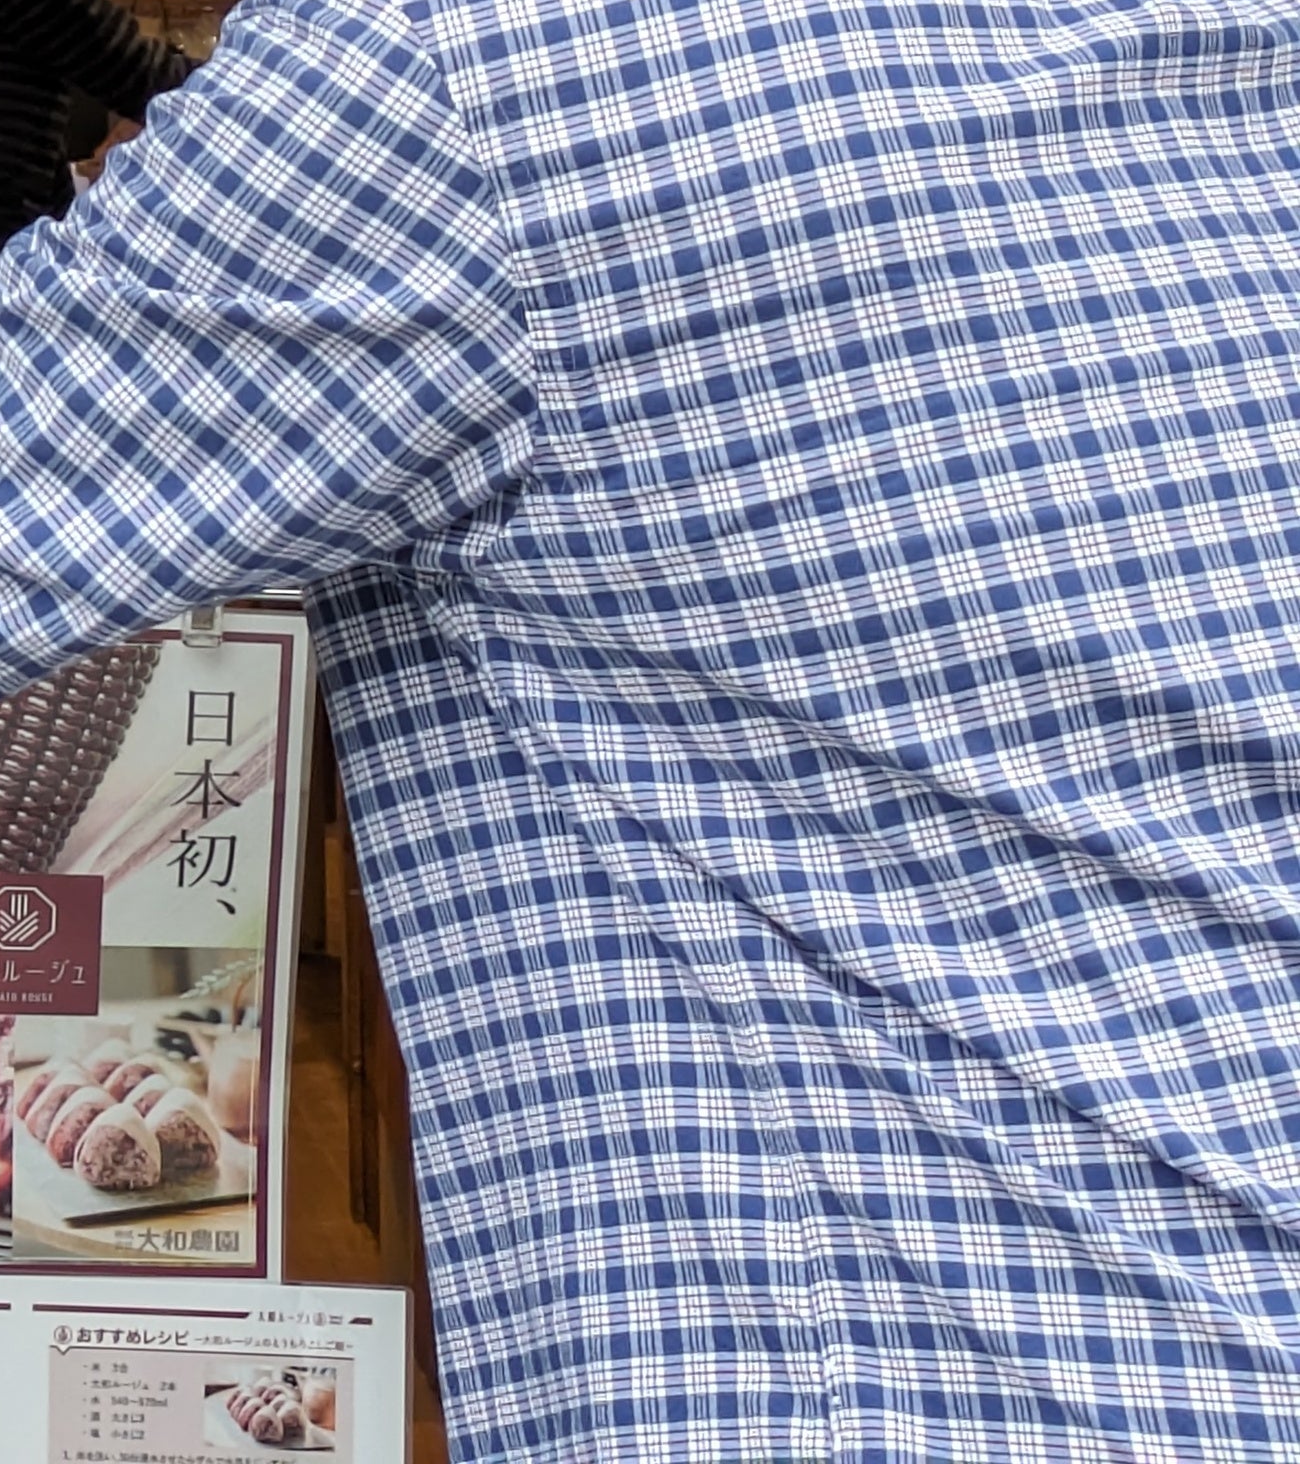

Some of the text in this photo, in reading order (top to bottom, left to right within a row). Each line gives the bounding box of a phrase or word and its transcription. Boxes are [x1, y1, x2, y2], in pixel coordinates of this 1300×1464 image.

[167, 689, 241, 916] 日本初、
[75, 1325, 190, 1347] おすすめレシピ
